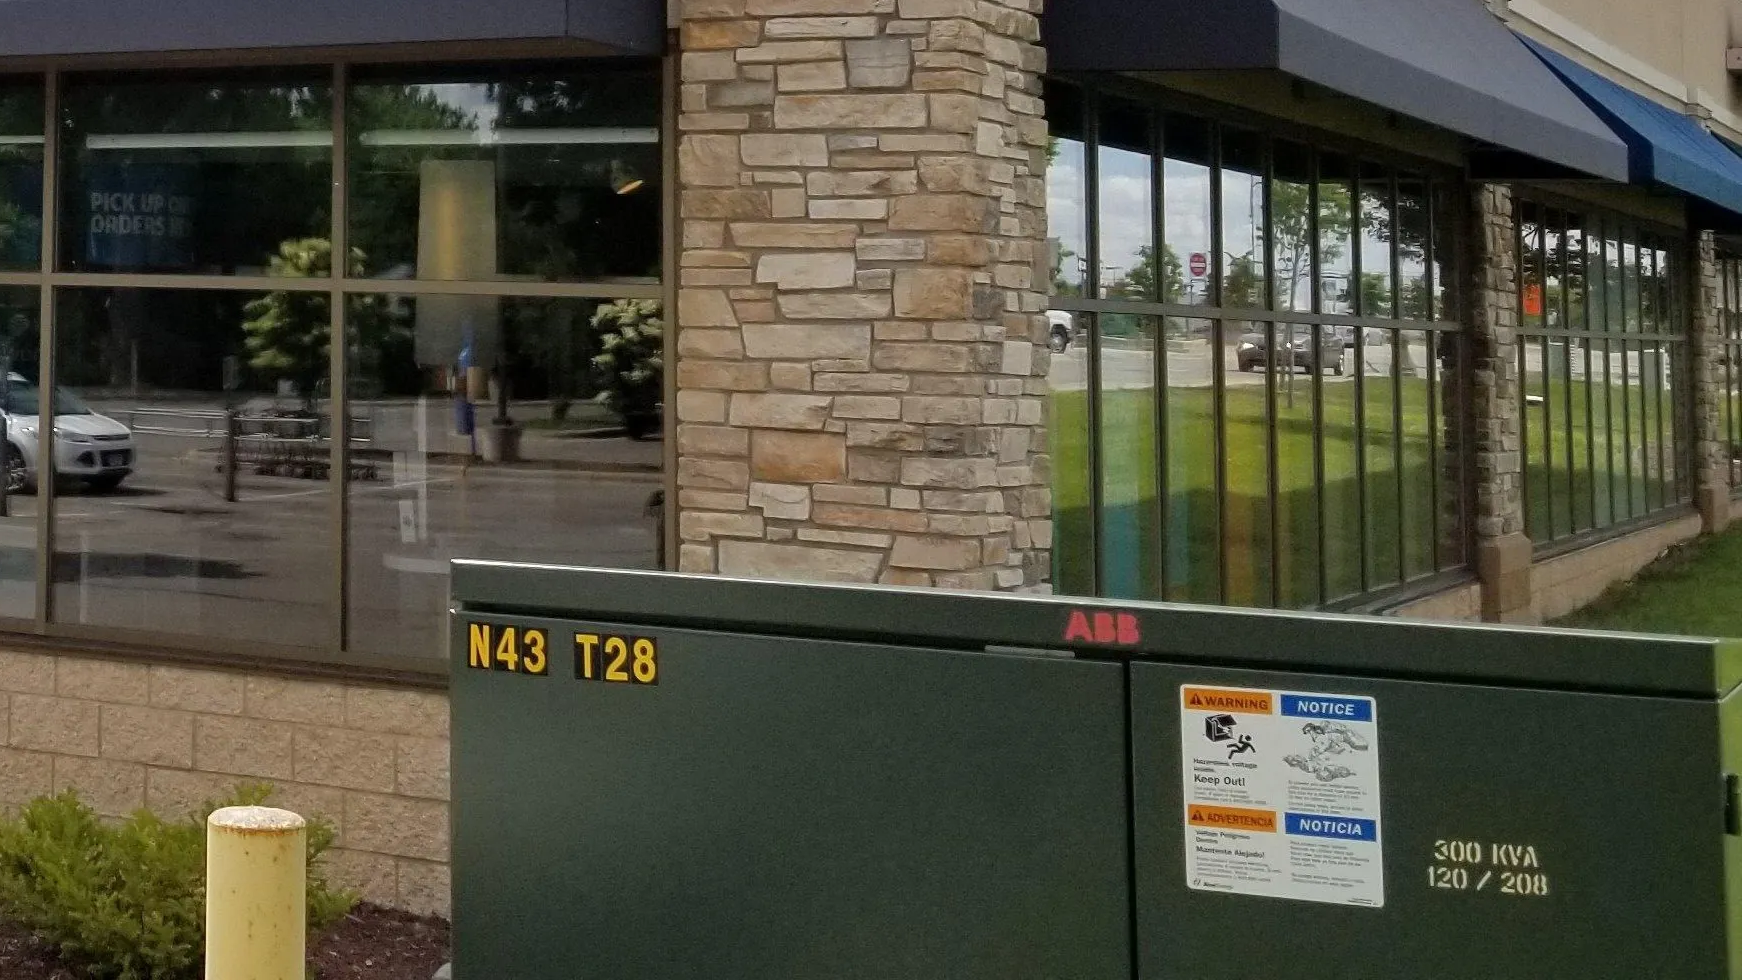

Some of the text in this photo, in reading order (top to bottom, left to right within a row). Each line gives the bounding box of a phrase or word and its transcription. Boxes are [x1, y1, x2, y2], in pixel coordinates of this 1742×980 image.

[91, 192, 134, 212] PICK
[1064, 610, 1140, 644] ABB
[469, 623, 657, 684] N43 T28
[1204, 693, 1269, 711] WARNING
[1297, 700, 1356, 716] NOTICE
[1193, 773, 1246, 787] Keep Out!
[1207, 811, 1275, 828] ADVERTENCIA
[1299, 818, 1363, 836] NOTICIA
[1434, 840, 1539, 868] 300 KVA
[1428, 866, 1468, 890] 120
[1500, 872, 1548, 895] 208
